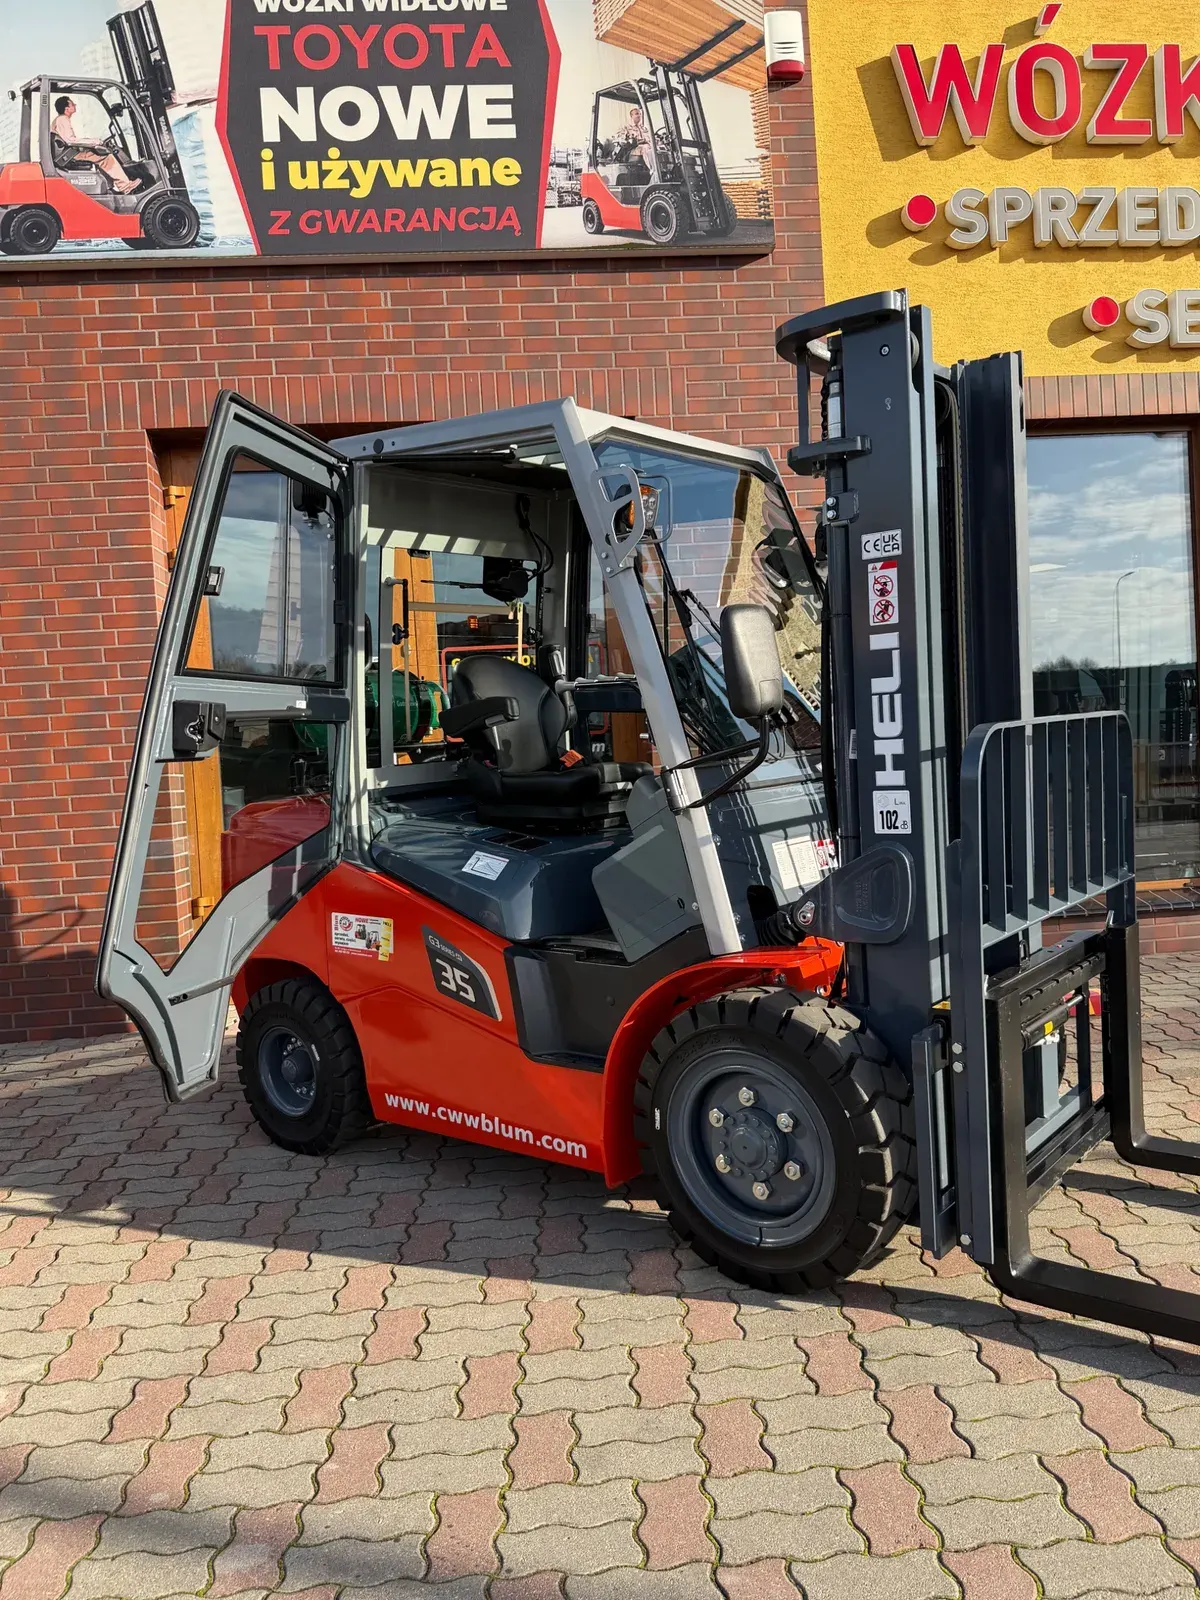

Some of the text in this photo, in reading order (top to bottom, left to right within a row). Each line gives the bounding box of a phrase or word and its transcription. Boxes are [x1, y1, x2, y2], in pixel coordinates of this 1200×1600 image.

[253, 23, 512, 70] TOYOTA
[889, 3, 1200, 146] WÓZK
[259, 84, 517, 142] NOWE
[260, 147, 522, 199] i używane
[268, 206, 522, 237] Z GWARANCJĄ
[945, 186, 1200, 250] SPRZED
[1125, 288, 1200, 350] SE
[883, 533, 898, 543] UK
[883, 542, 900, 553] CA
[869, 632, 906, 786] HELI
[879, 810, 909, 830] 102 dB
[435, 958, 476, 1003] 35
[384, 1092, 588, 1159] www.cwwblum.com
